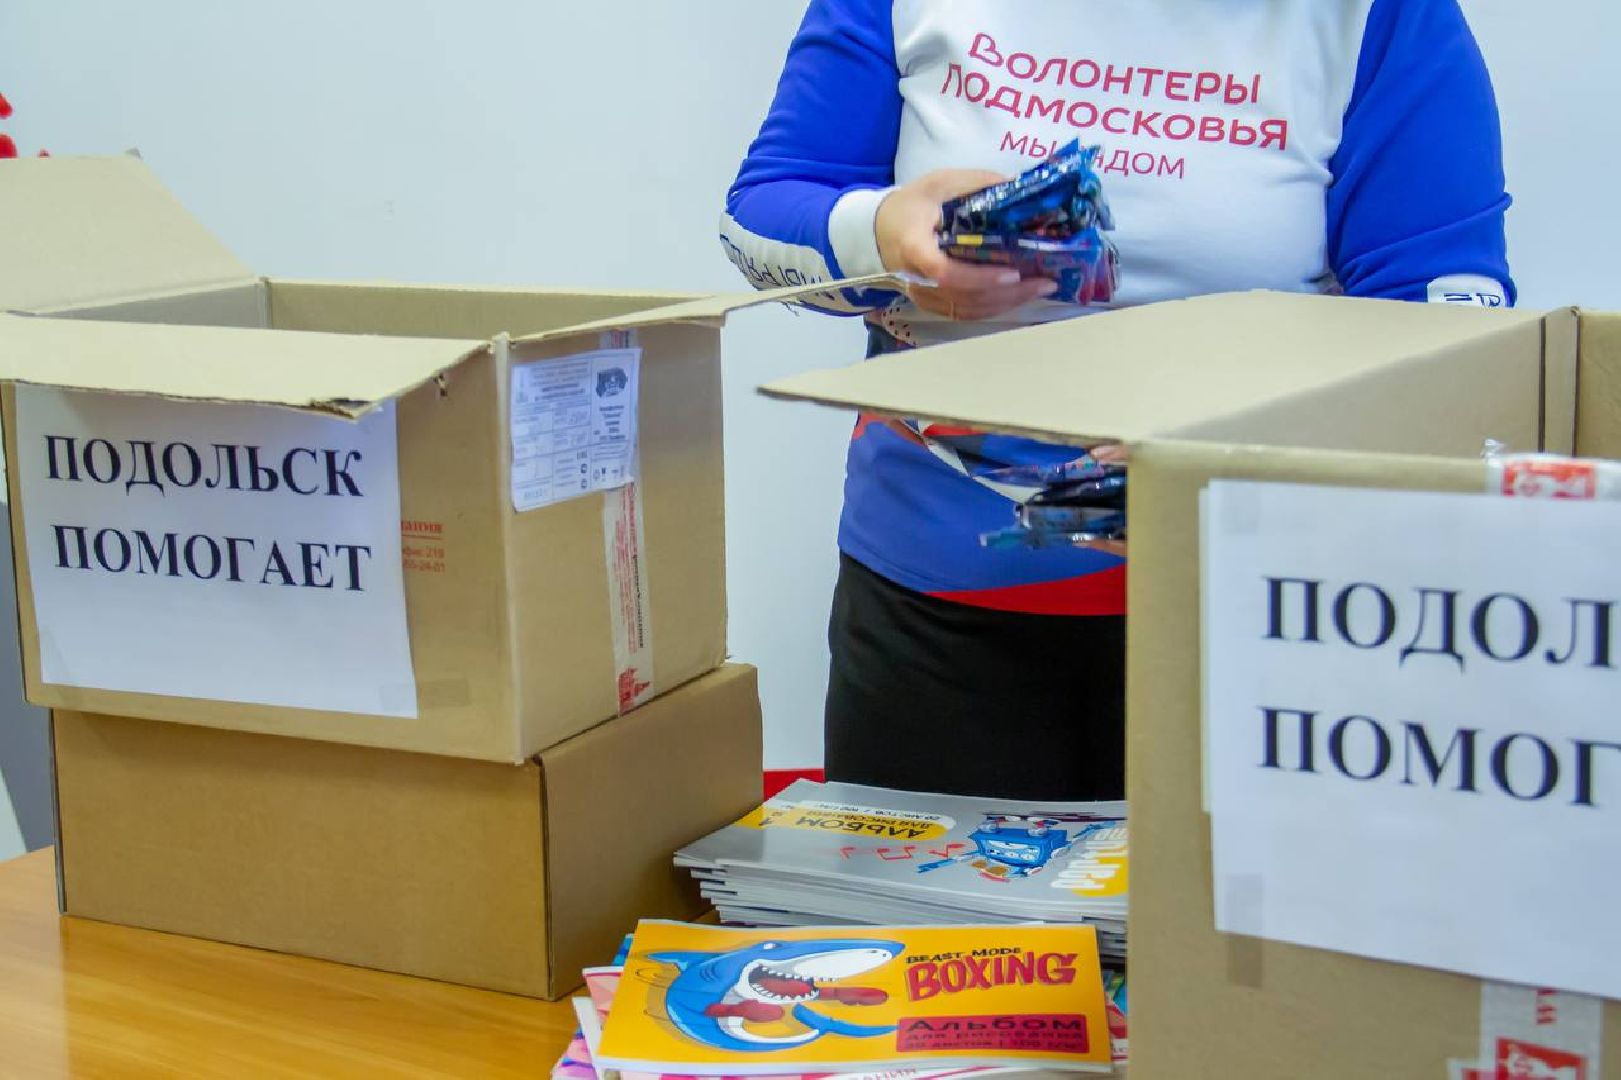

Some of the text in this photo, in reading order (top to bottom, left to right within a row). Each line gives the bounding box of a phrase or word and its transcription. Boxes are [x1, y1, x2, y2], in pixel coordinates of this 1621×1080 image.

[968, 33, 1261, 106] ВОЛОНТЕРЫ
[941, 63, 1288, 150] ПОДМОСКОВЬЯ
[1096, 149, 1185, 180] ДОМ
[44, 434, 363, 497] ПОДОЛЬСК
[51, 524, 371, 592] ПОМОГАЕТ
[1260, 574, 1620, 672] ПОДОЛ
[1256, 706, 1621, 808] ПОМОГ
[796, 816, 926, 838] АЛЬБОМ
[905, 951, 1079, 1002] BOXING
[906, 947, 1021, 964] BEAST MODE
[906, 1016, 1081, 1032] Альбом
